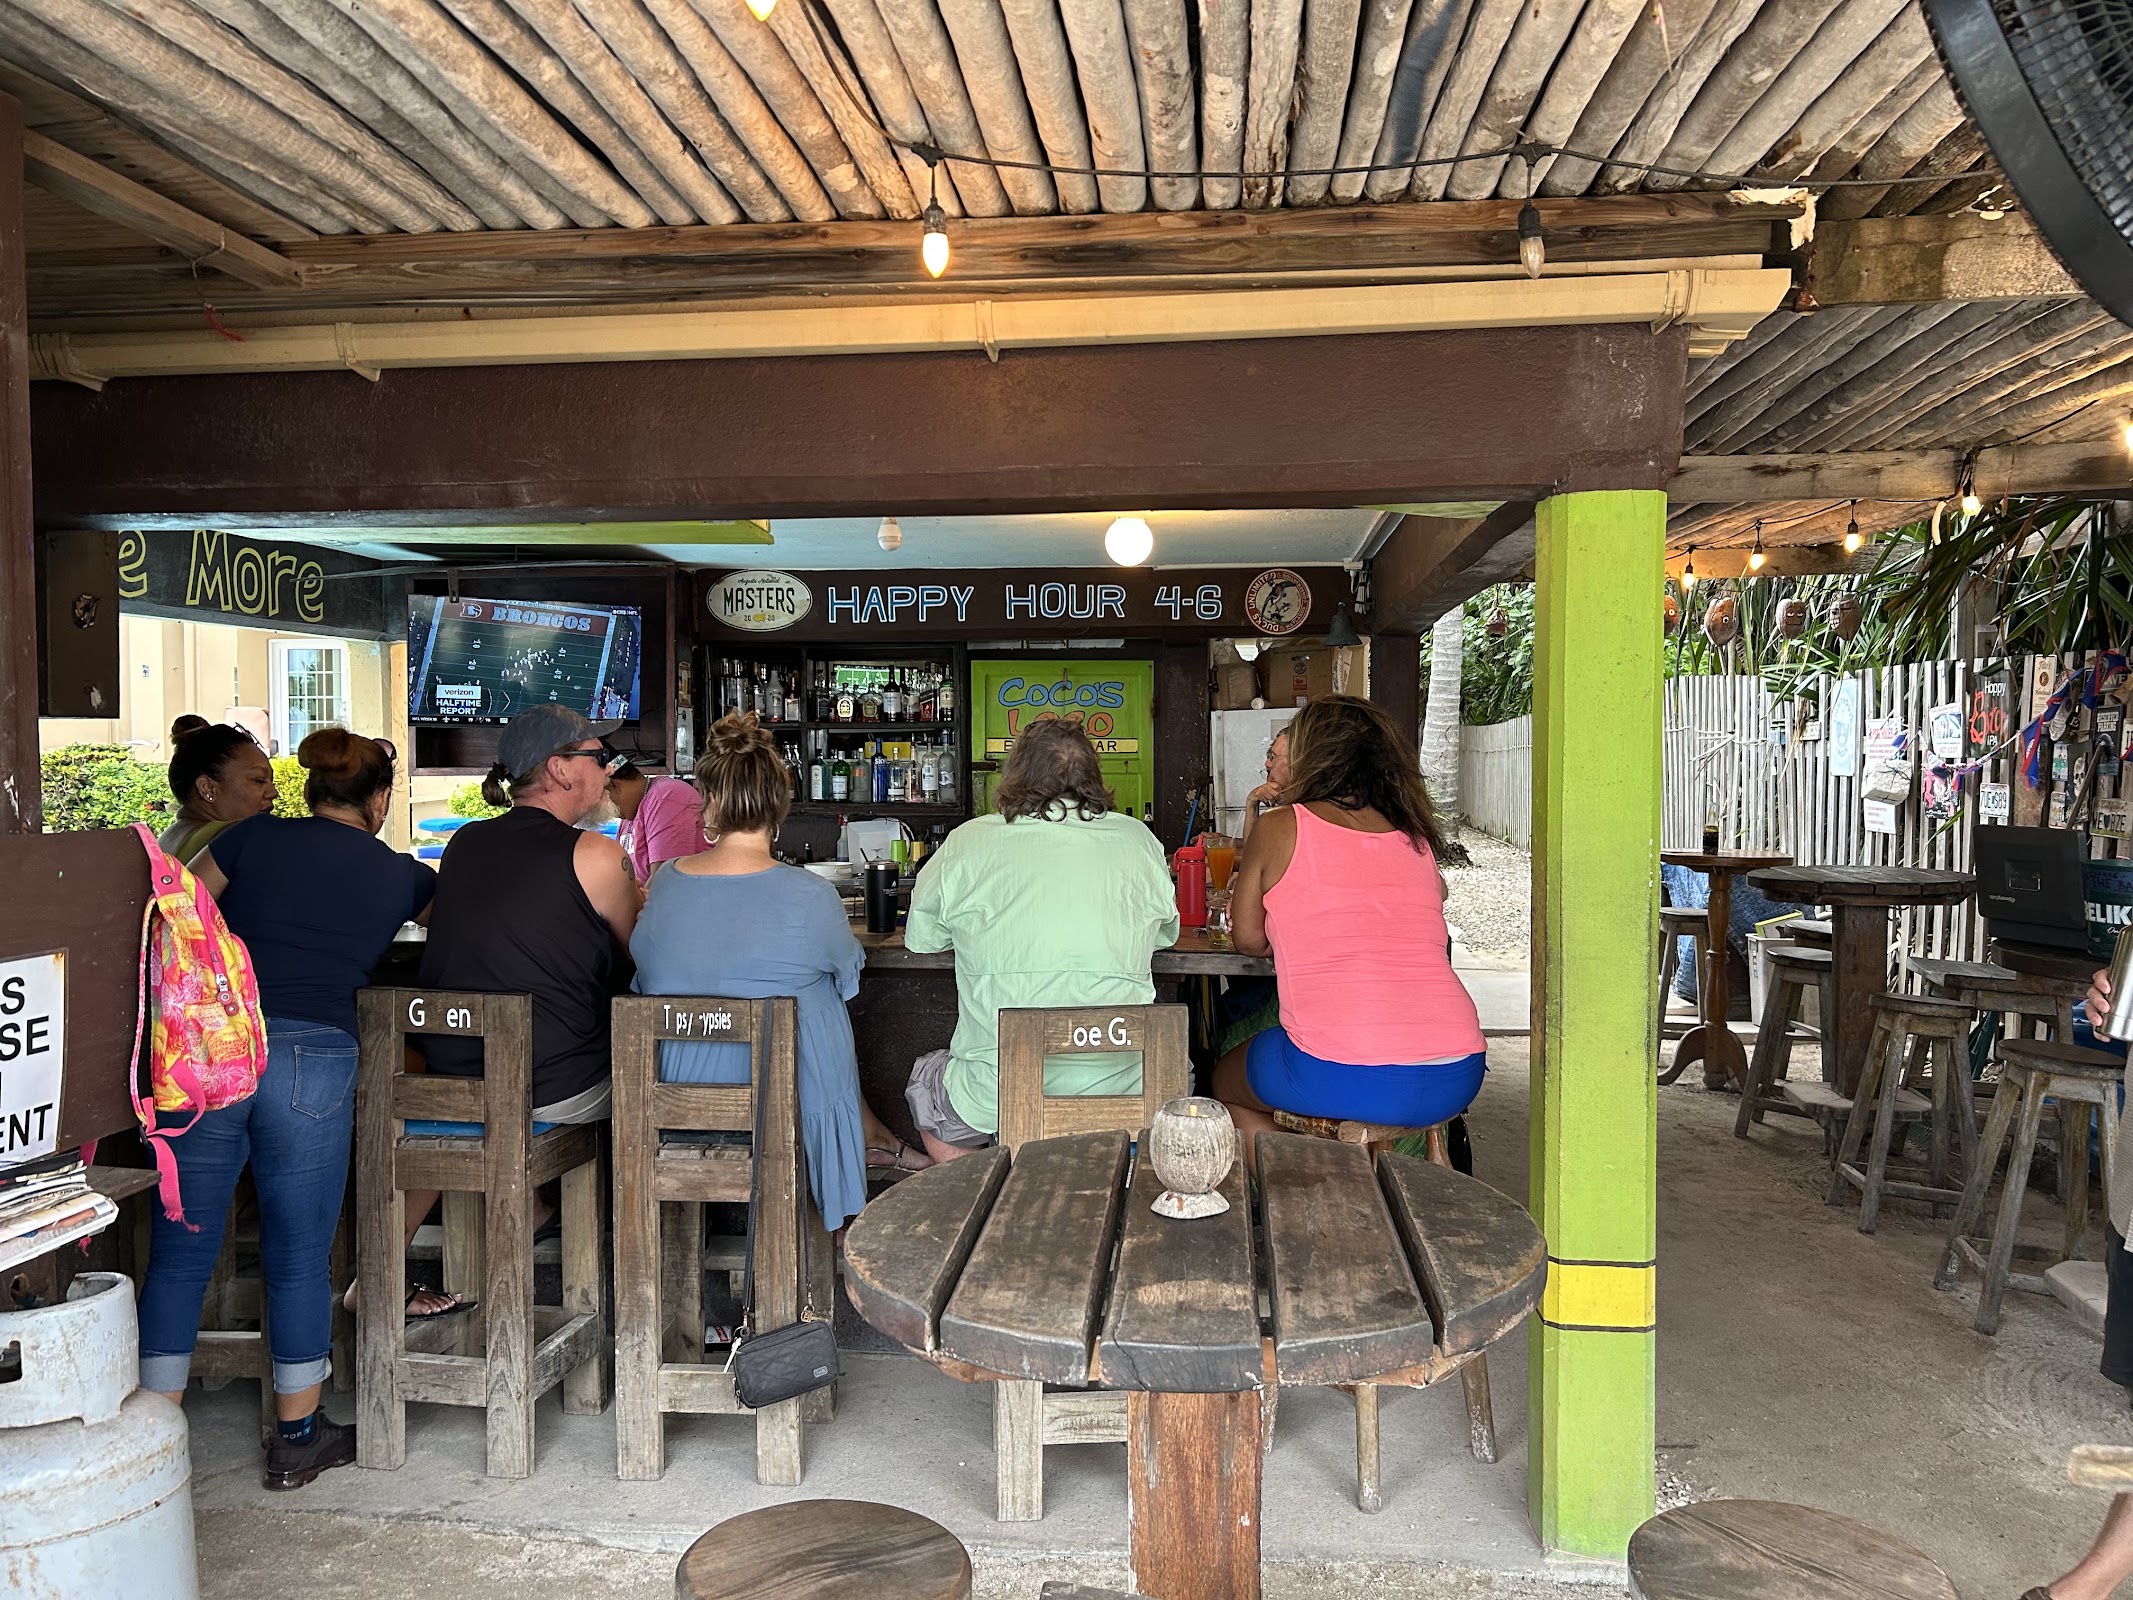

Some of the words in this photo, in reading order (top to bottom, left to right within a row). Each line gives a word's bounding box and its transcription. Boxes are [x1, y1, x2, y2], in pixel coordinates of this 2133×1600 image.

[185, 530, 324, 623] More
[723, 587, 795, 617] MASTERS
[828, 585, 975, 624] HAPPY
[1005, 582, 1126, 620] HOUR
[1153, 584, 1223, 621] 4-6
[491, 606, 592, 632] BRONCOS
[1252, 613, 1279, 632] DUCKS
[444, 688, 474, 697] verizon
[1984, 681, 2007, 697] Hoppy
[435, 698, 482, 708] HALFTIME
[439, 706, 477, 715] REPORT
[1986, 735, 1998, 746] IPA
[1108, 1016, 1132, 1046] G.
